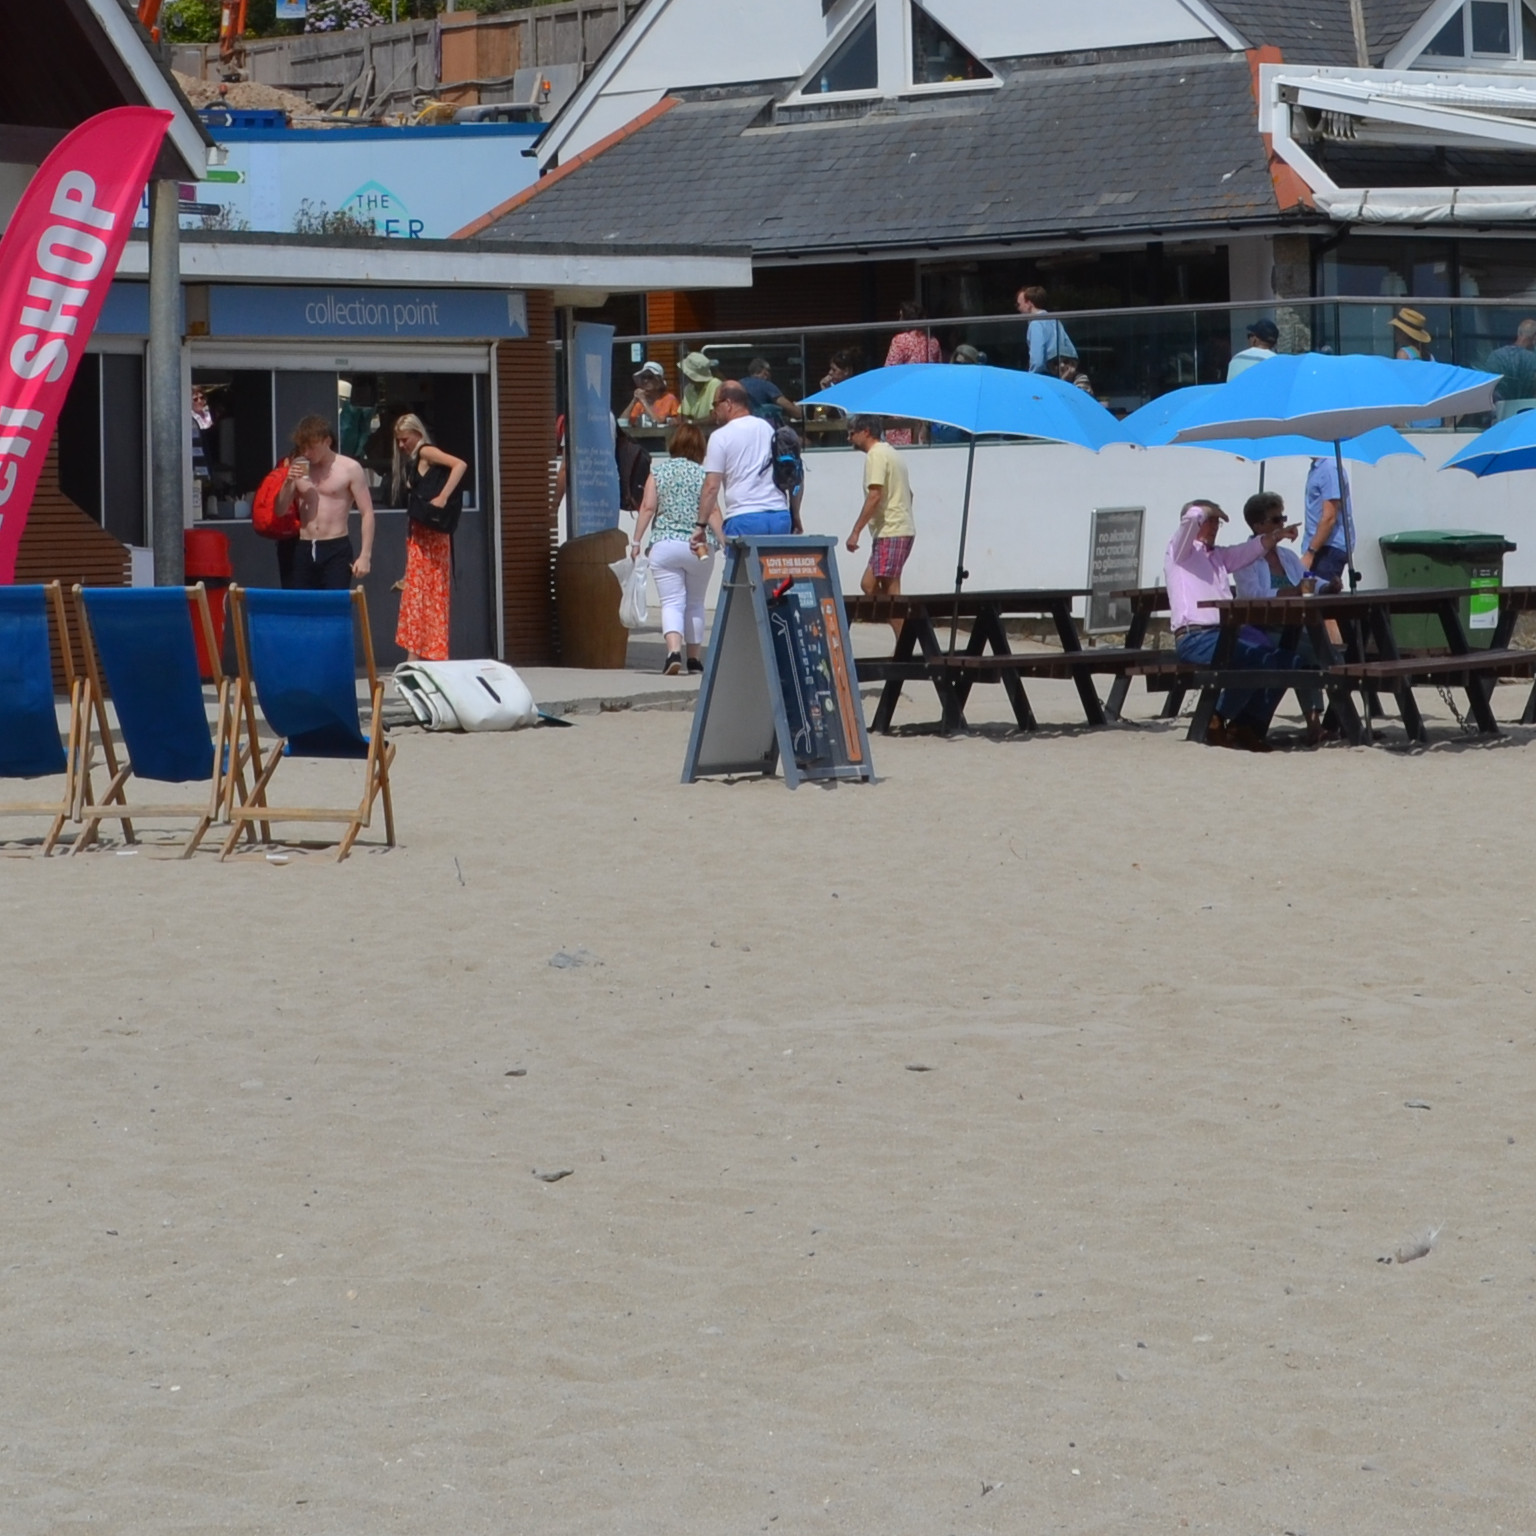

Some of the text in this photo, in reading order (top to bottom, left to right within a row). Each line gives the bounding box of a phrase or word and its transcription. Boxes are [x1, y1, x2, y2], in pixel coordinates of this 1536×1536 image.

[356, 194, 390, 209] THE
[10, 169, 117, 383] SHOP
[305, 295, 440, 332] collection point
[1098, 529, 1136, 543] no alcohol
[1096, 546, 1106, 556] no
[1093, 560, 1103, 570] no
